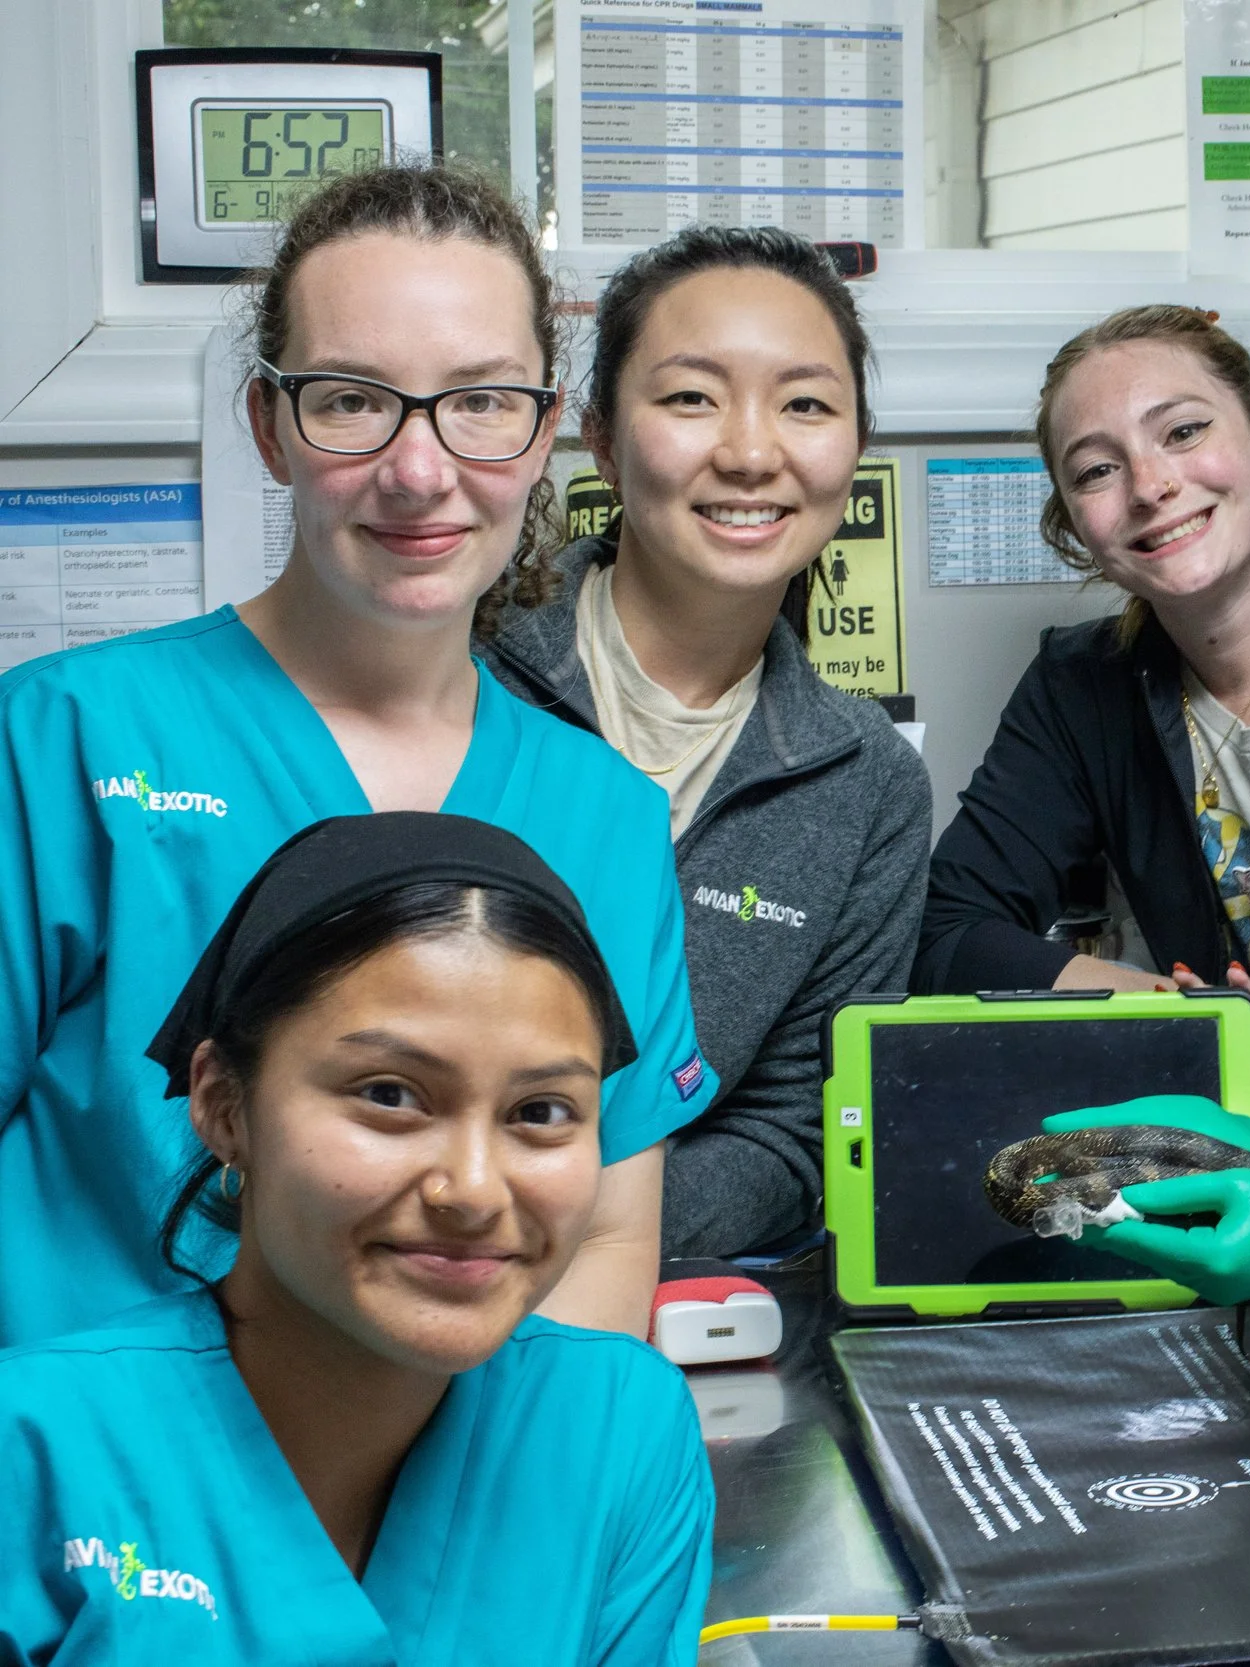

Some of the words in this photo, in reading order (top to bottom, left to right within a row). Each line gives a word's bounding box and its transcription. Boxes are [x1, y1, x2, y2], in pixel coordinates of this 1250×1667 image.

[655, 0, 670, 8] CPR
[672, 1, 694, 10] Drugs
[212, 131, 226, 139] PM
[242, 112, 349, 177] 6:52
[8, 494, 21, 505] of
[25, 491, 141, 506] Anesthesiologists
[143, 489, 182, 504] (ASA)
[63, 528, 108, 539] Examples
[64, 560, 116, 571] orthopaedic
[118, 559, 148, 570] patient
[2, 592, 17, 600] risk
[65, 590, 102, 599] Neonate
[155, 585, 200, 596] Controlled
[818, 606, 875, 636] USE
[21, 630, 36, 639] risk
[110, 627, 125, 635] low
[826, 660, 860, 678] may
[866, 655, 885, 673] be
[149, 791, 228, 818] EXOTIC
[692, 885, 741, 914] AVIAN
[755, 900, 808, 928] EXOTIC
[64, 1536, 120, 1586] AVI
[140, 1569, 219, 1621] EXOTI
